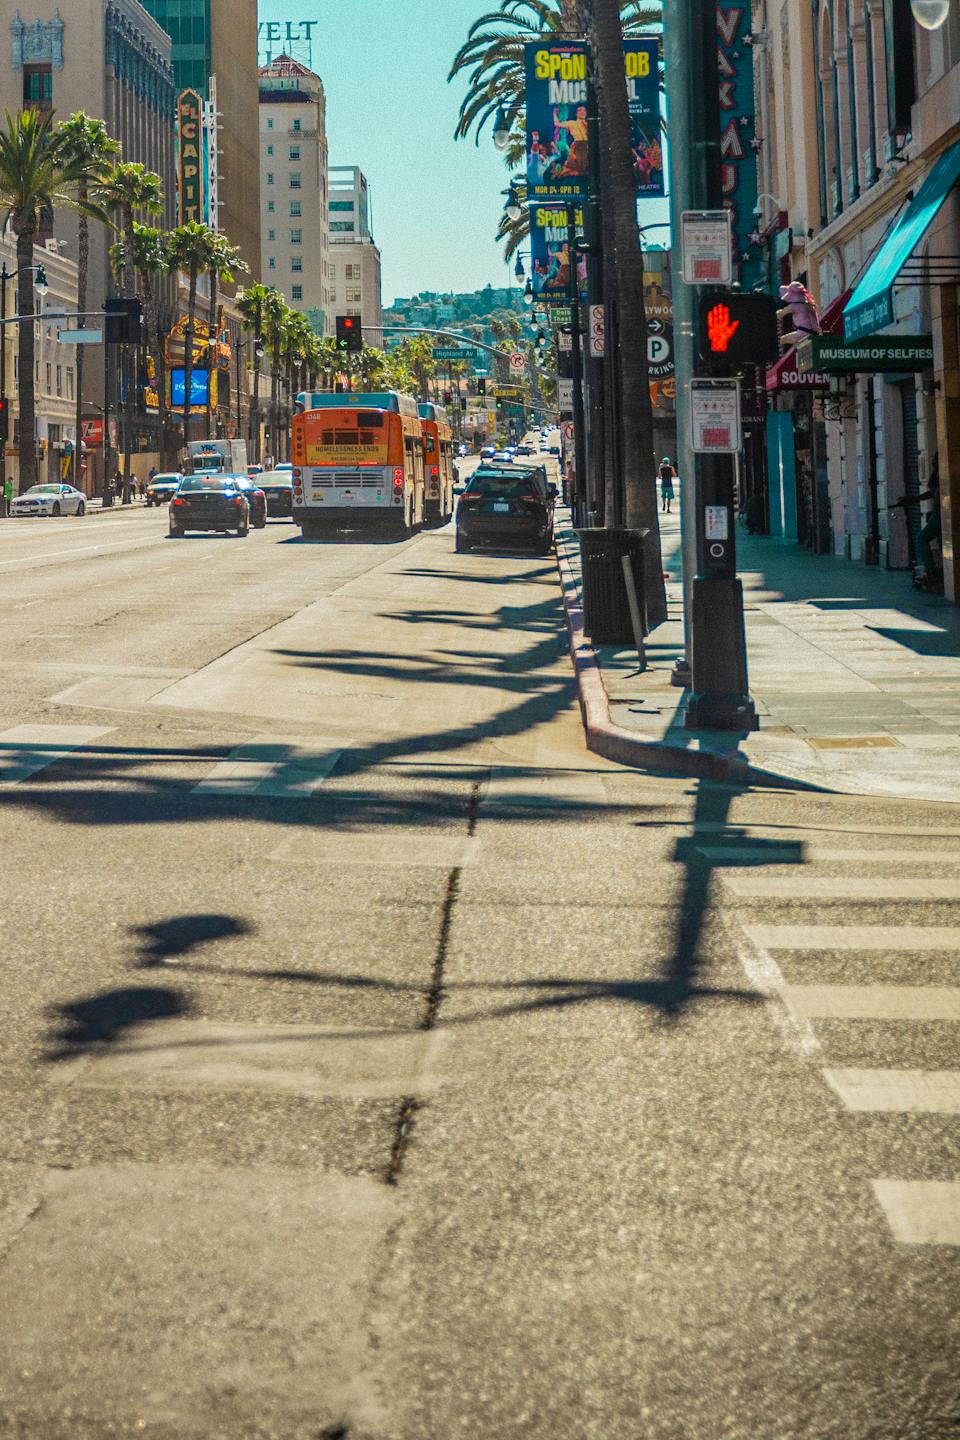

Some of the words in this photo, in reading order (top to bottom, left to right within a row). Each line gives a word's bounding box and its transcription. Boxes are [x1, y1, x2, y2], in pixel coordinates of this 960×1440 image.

[181, 103, 198, 120] EL
[436, 350, 464, 358] Highland
[651, 340, 662, 358] P
[819, 348, 870, 359] MUSEUM
[870, 348, 886, 358] OF
[887, 348, 933, 359] SELFIES
